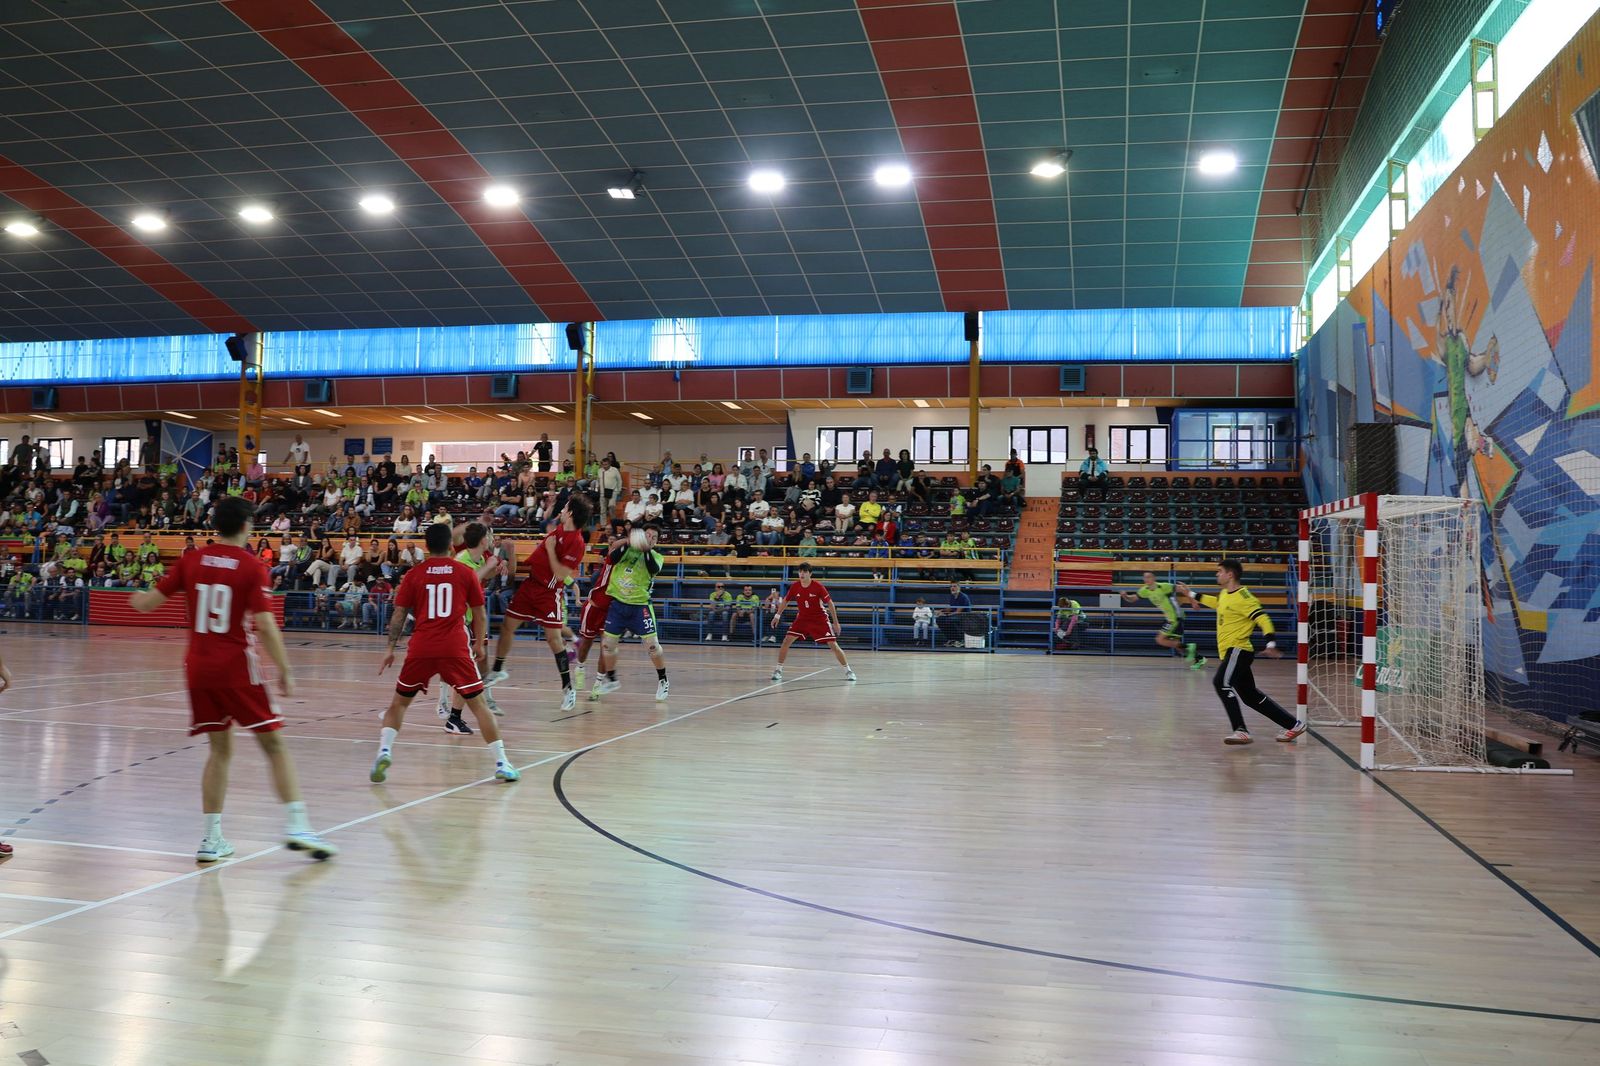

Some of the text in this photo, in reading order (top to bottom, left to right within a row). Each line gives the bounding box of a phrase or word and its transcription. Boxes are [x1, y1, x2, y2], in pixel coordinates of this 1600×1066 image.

[194, 582, 233, 634] 19
[425, 582, 453, 619] 10
[642, 618, 654, 629] 32
